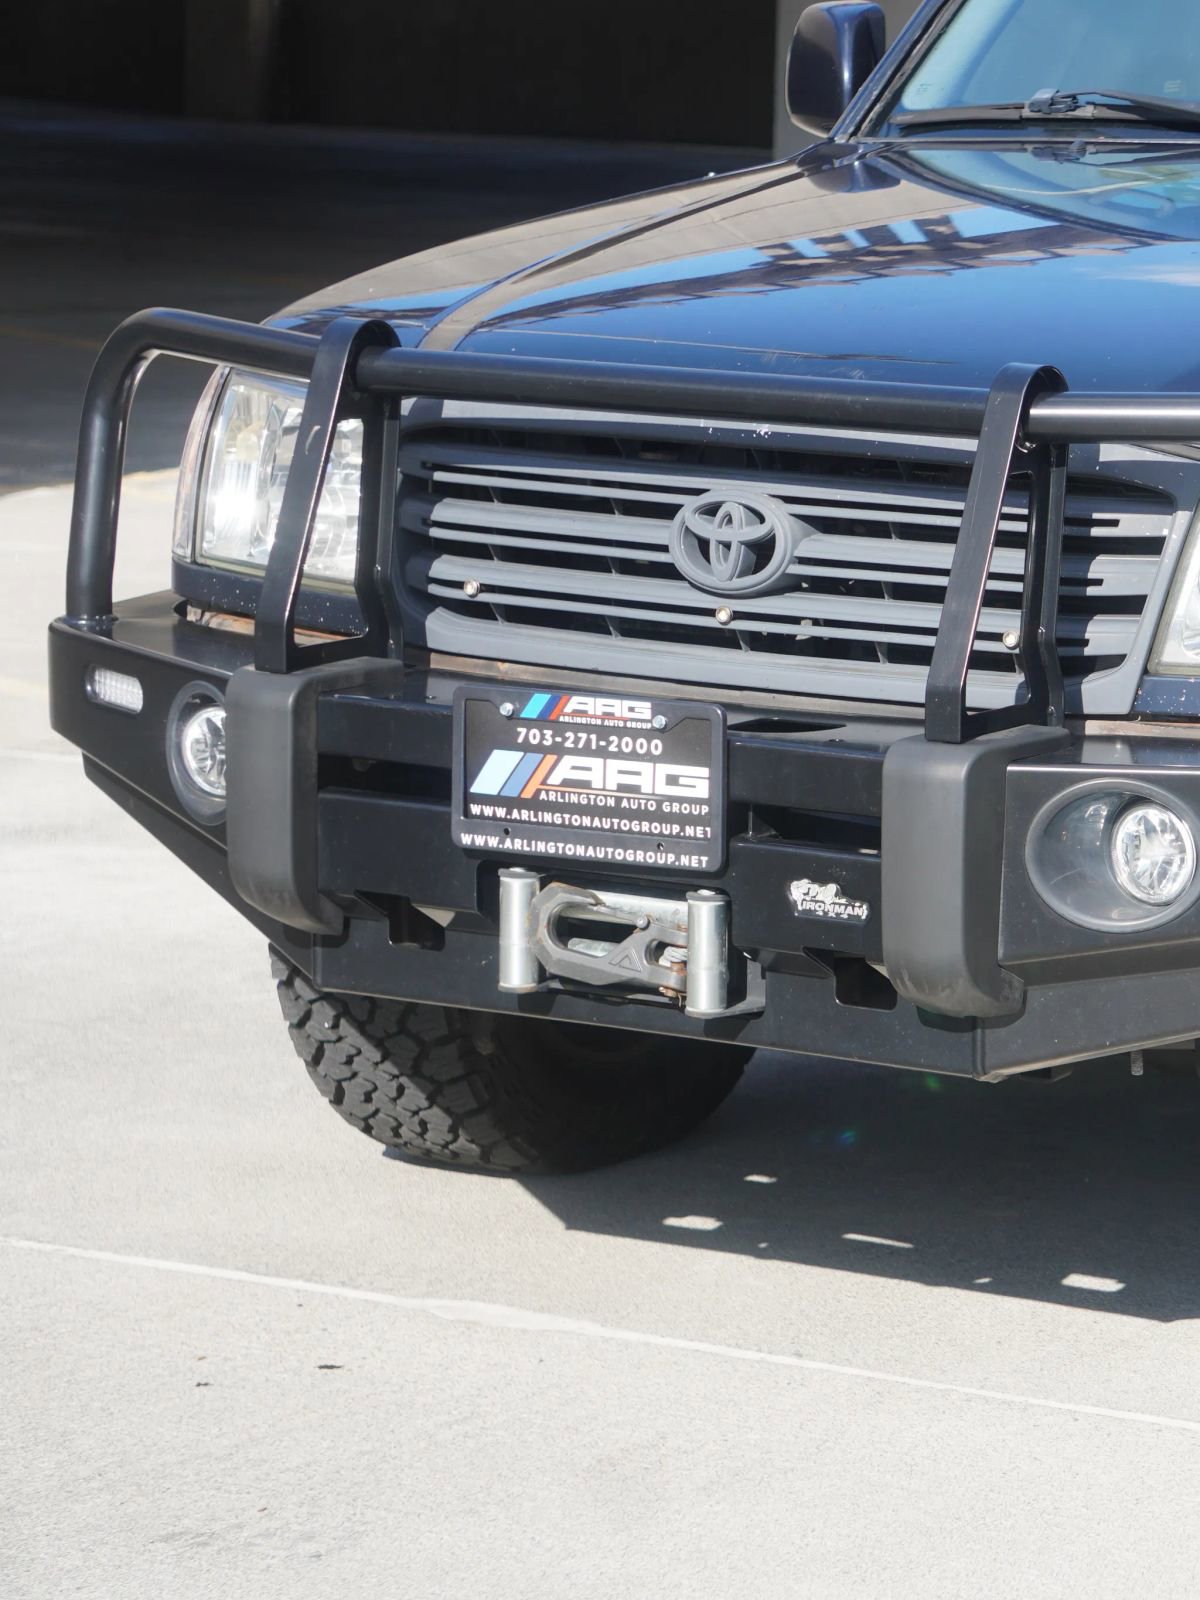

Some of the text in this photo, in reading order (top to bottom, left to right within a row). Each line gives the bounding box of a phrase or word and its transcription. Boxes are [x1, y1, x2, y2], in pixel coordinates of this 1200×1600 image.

[562, 695, 652, 720] AAG
[559, 714, 652, 730] ARLINGTON AUTO GROUP
[516, 727, 663, 755] 703-271-2000
[546, 755, 710, 798] AAG
[539, 790, 709, 816] ARLINGTON AUTO GROUP
[470, 803, 711, 839] WWW.ARLINGTONAUTOGROUP.NET
[460, 832, 709, 868] WWW.ARLINGTONAUTOGROUP.NET
[801, 900, 863, 917] IRONMAN
